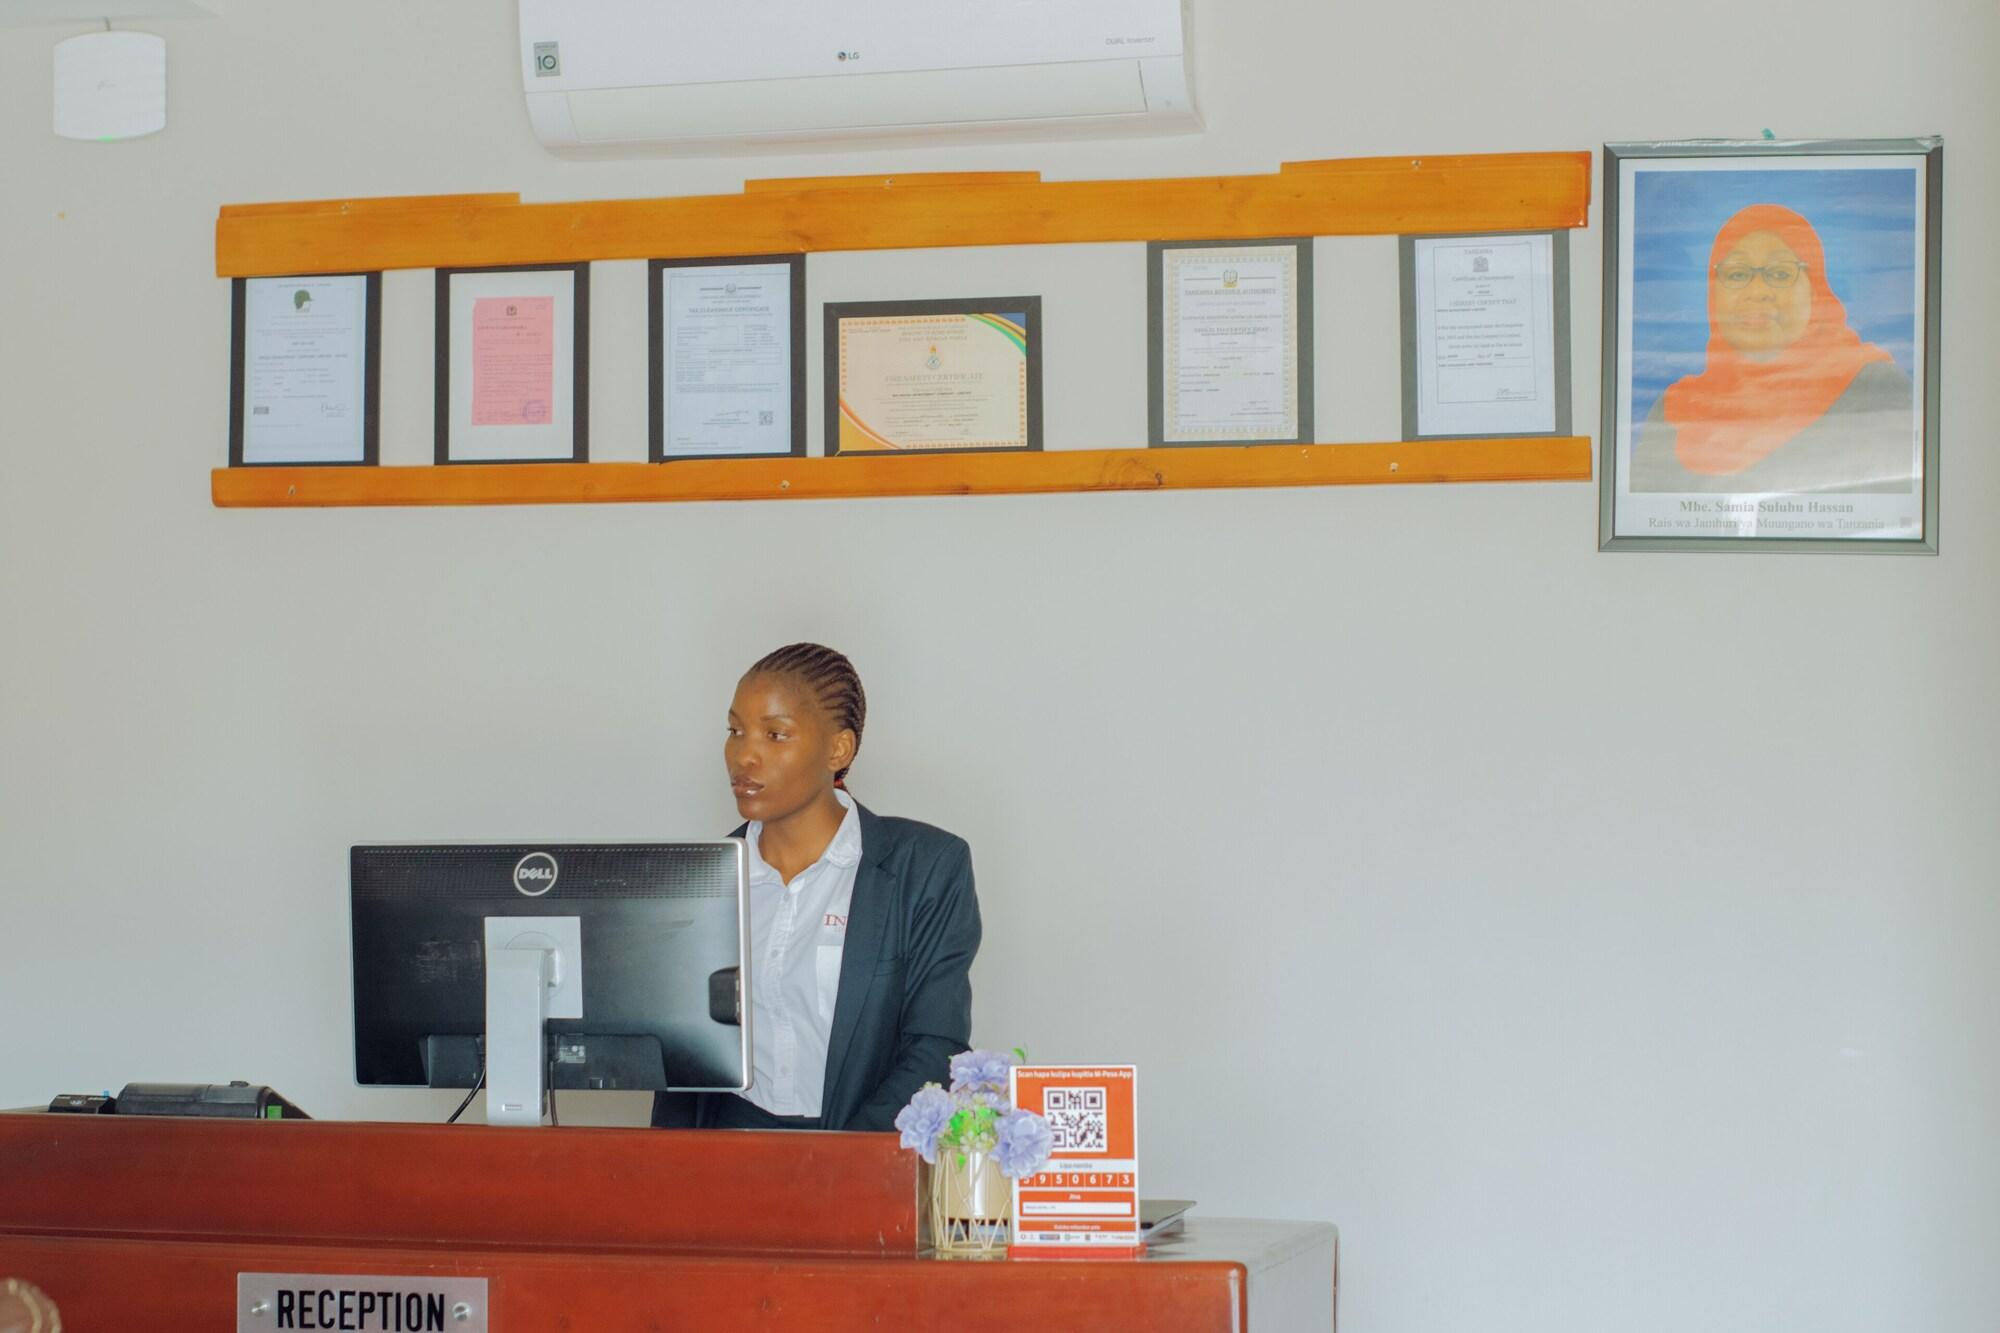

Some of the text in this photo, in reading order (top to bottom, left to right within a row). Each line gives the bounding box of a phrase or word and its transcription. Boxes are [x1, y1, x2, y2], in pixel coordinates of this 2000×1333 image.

[848, 51, 860, 60] LG
[1680, 501, 1854, 513] Mhe. Samia Suluhu Hassan
[1648, 517, 1672, 529] Rais
[1676, 520, 1691, 529] wa
[1757, 518, 1815, 532] Muungano
[1818, 520, 1834, 529] wa
[1836, 517, 1885, 530] Tanzania
[519, 867, 553, 880] DELL
[277, 1289, 445, 1332] RECEPTION
